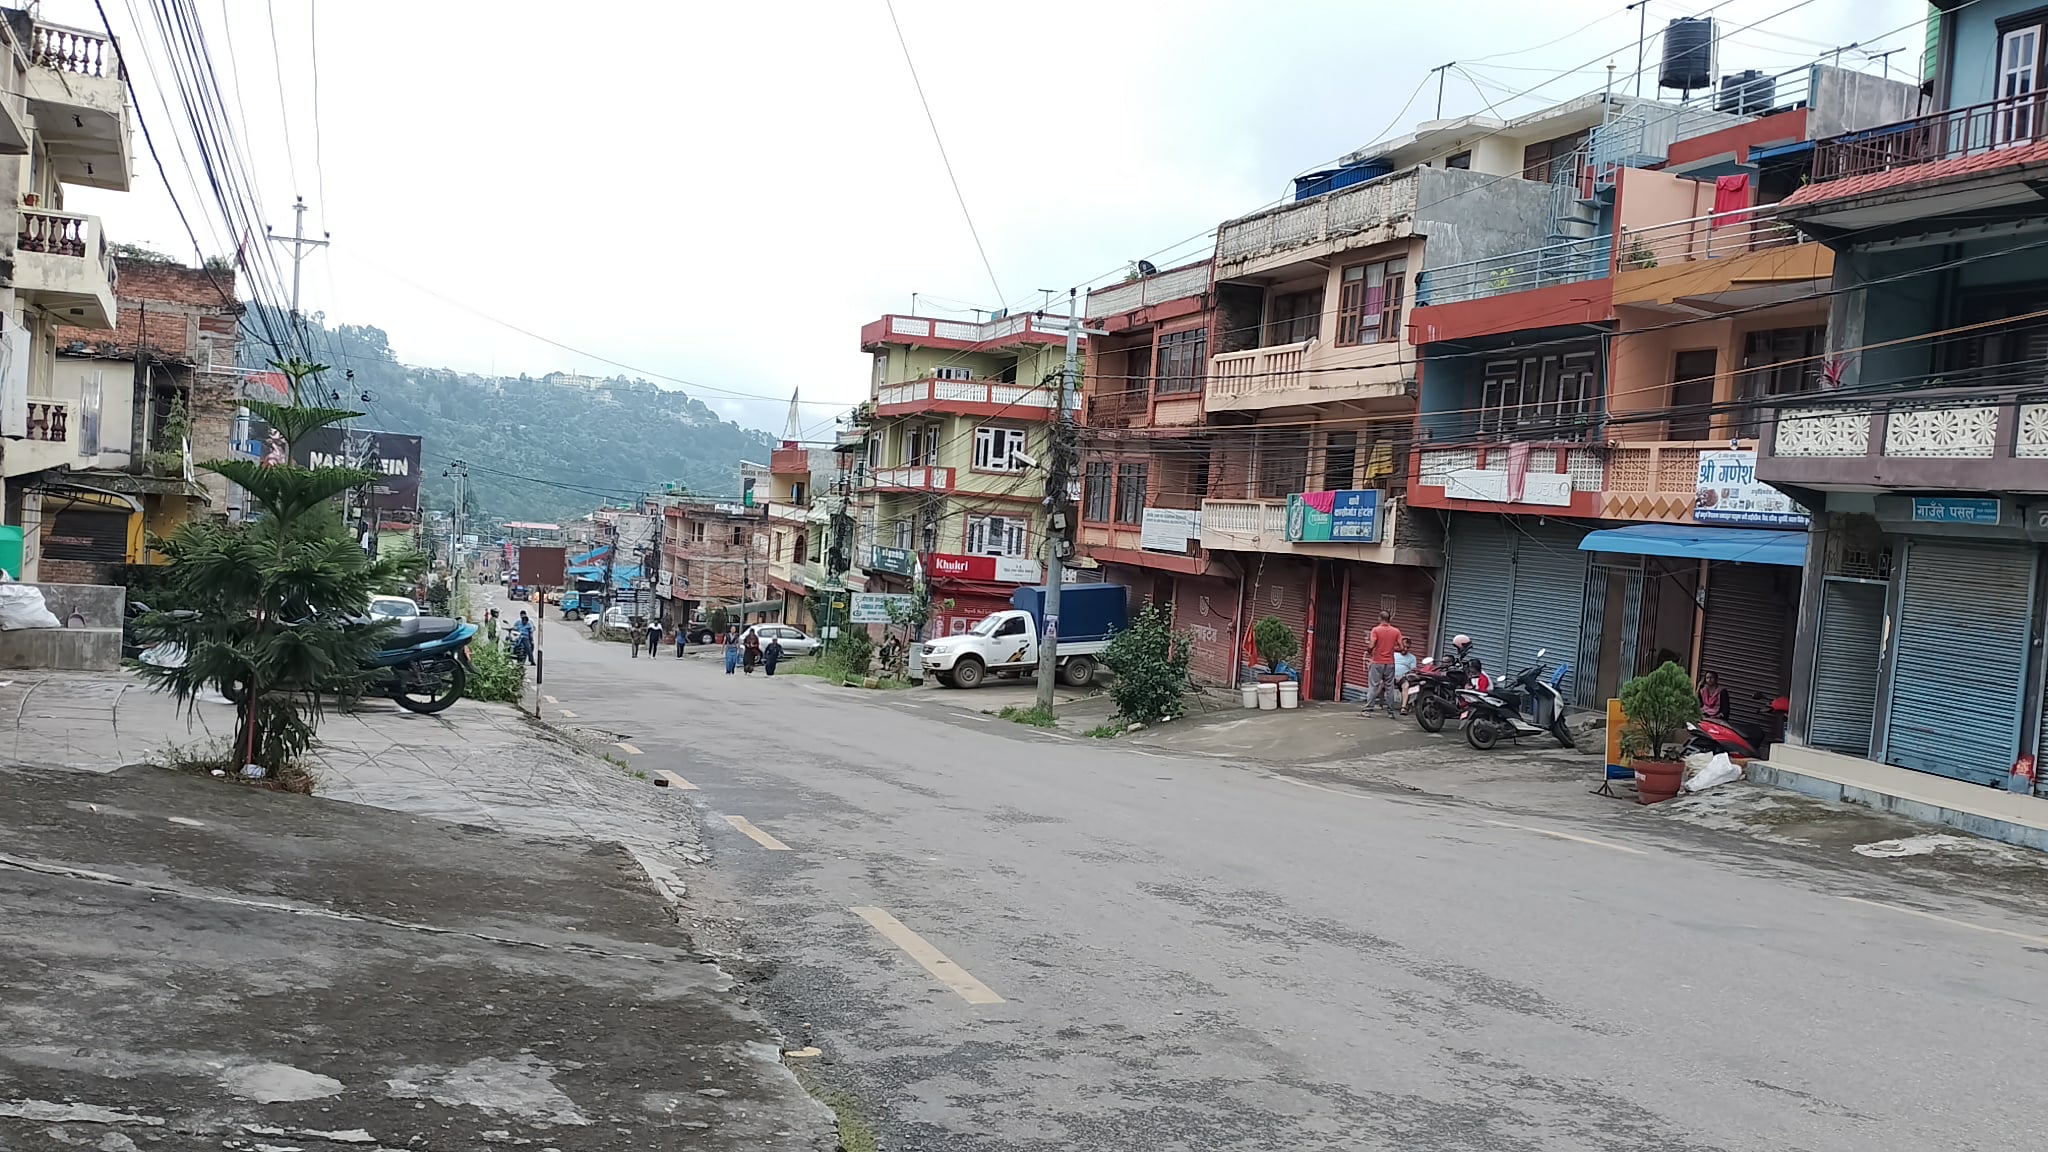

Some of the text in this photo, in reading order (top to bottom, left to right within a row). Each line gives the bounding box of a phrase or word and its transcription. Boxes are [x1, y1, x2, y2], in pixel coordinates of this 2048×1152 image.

[1700, 459, 1754, 485] श्री गणेश
[1917, 501, 1975, 520] गाउँले पसल
[936, 558, 968, 571] Khukri
